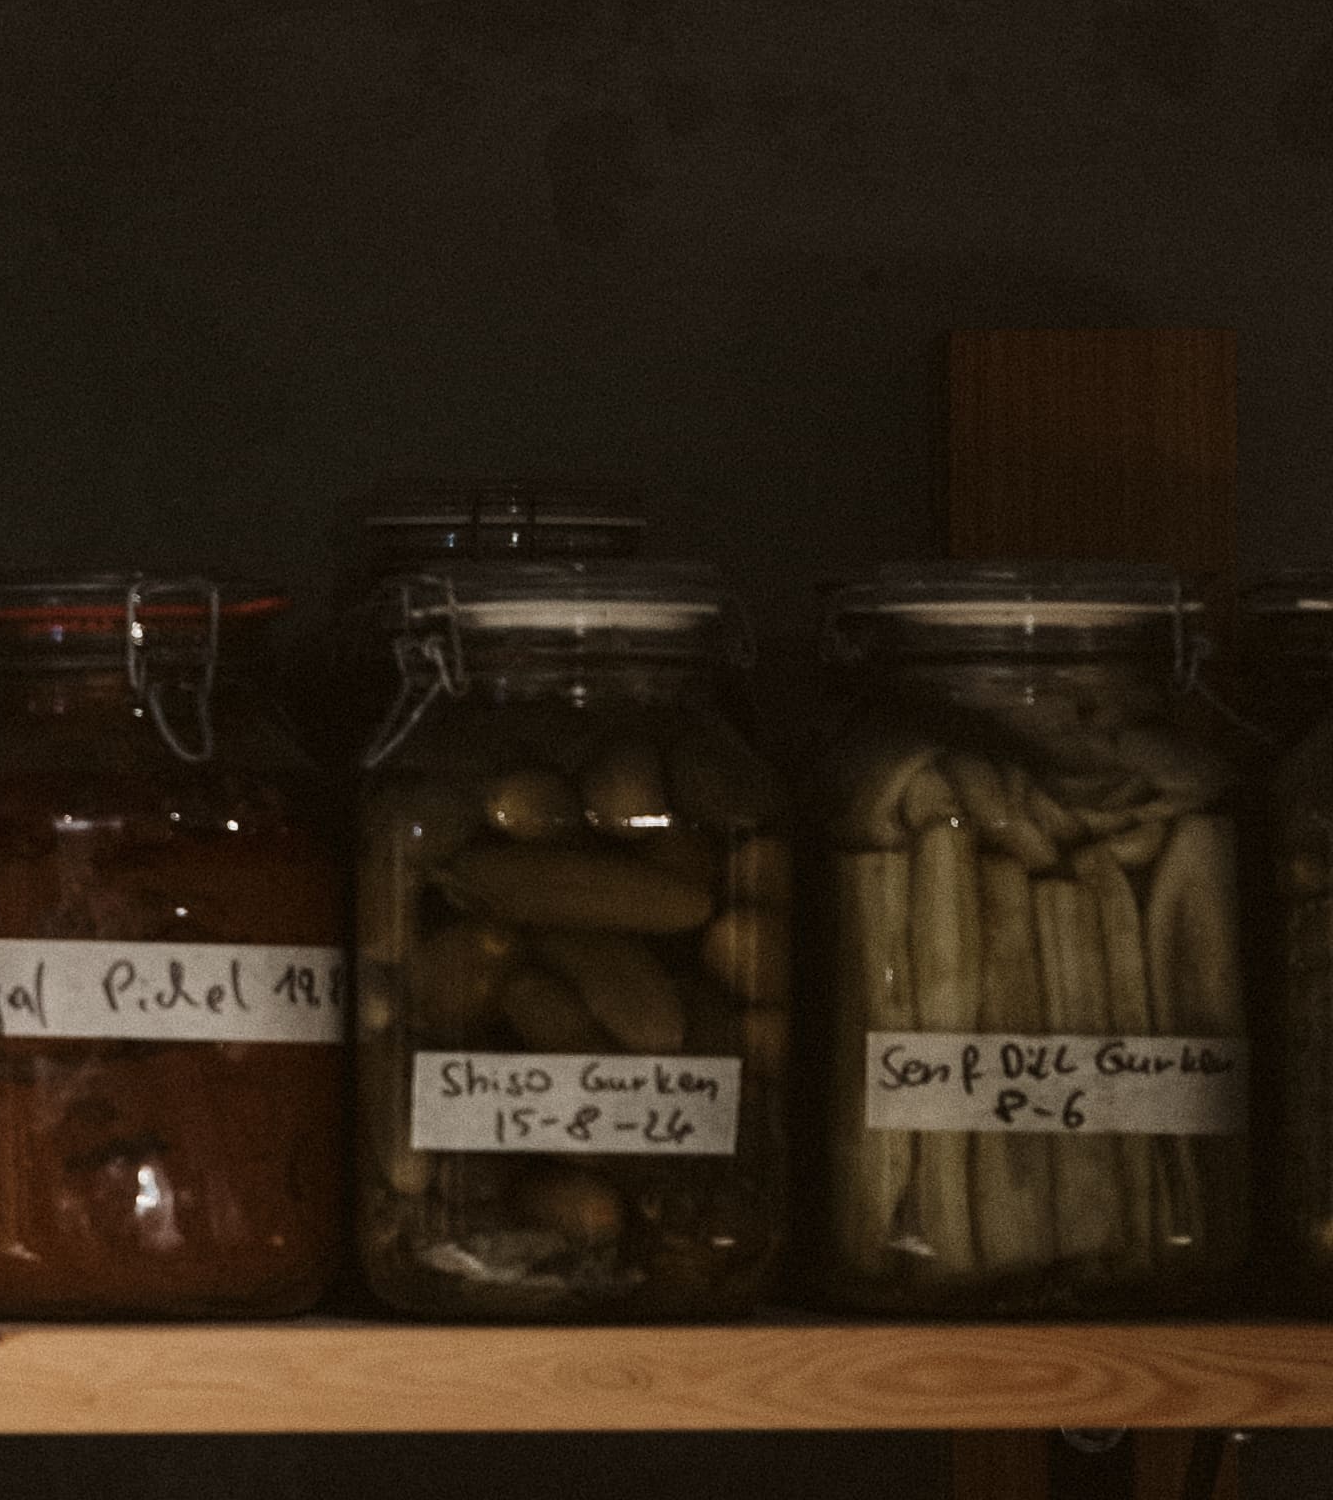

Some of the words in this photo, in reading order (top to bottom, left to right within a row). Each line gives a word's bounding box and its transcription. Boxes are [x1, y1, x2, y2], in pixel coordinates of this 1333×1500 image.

[440, 1057, 554, 1098] Shiso
[578, 1061, 720, 1101] Gurken
[878, 1044, 986, 1095] Senf
